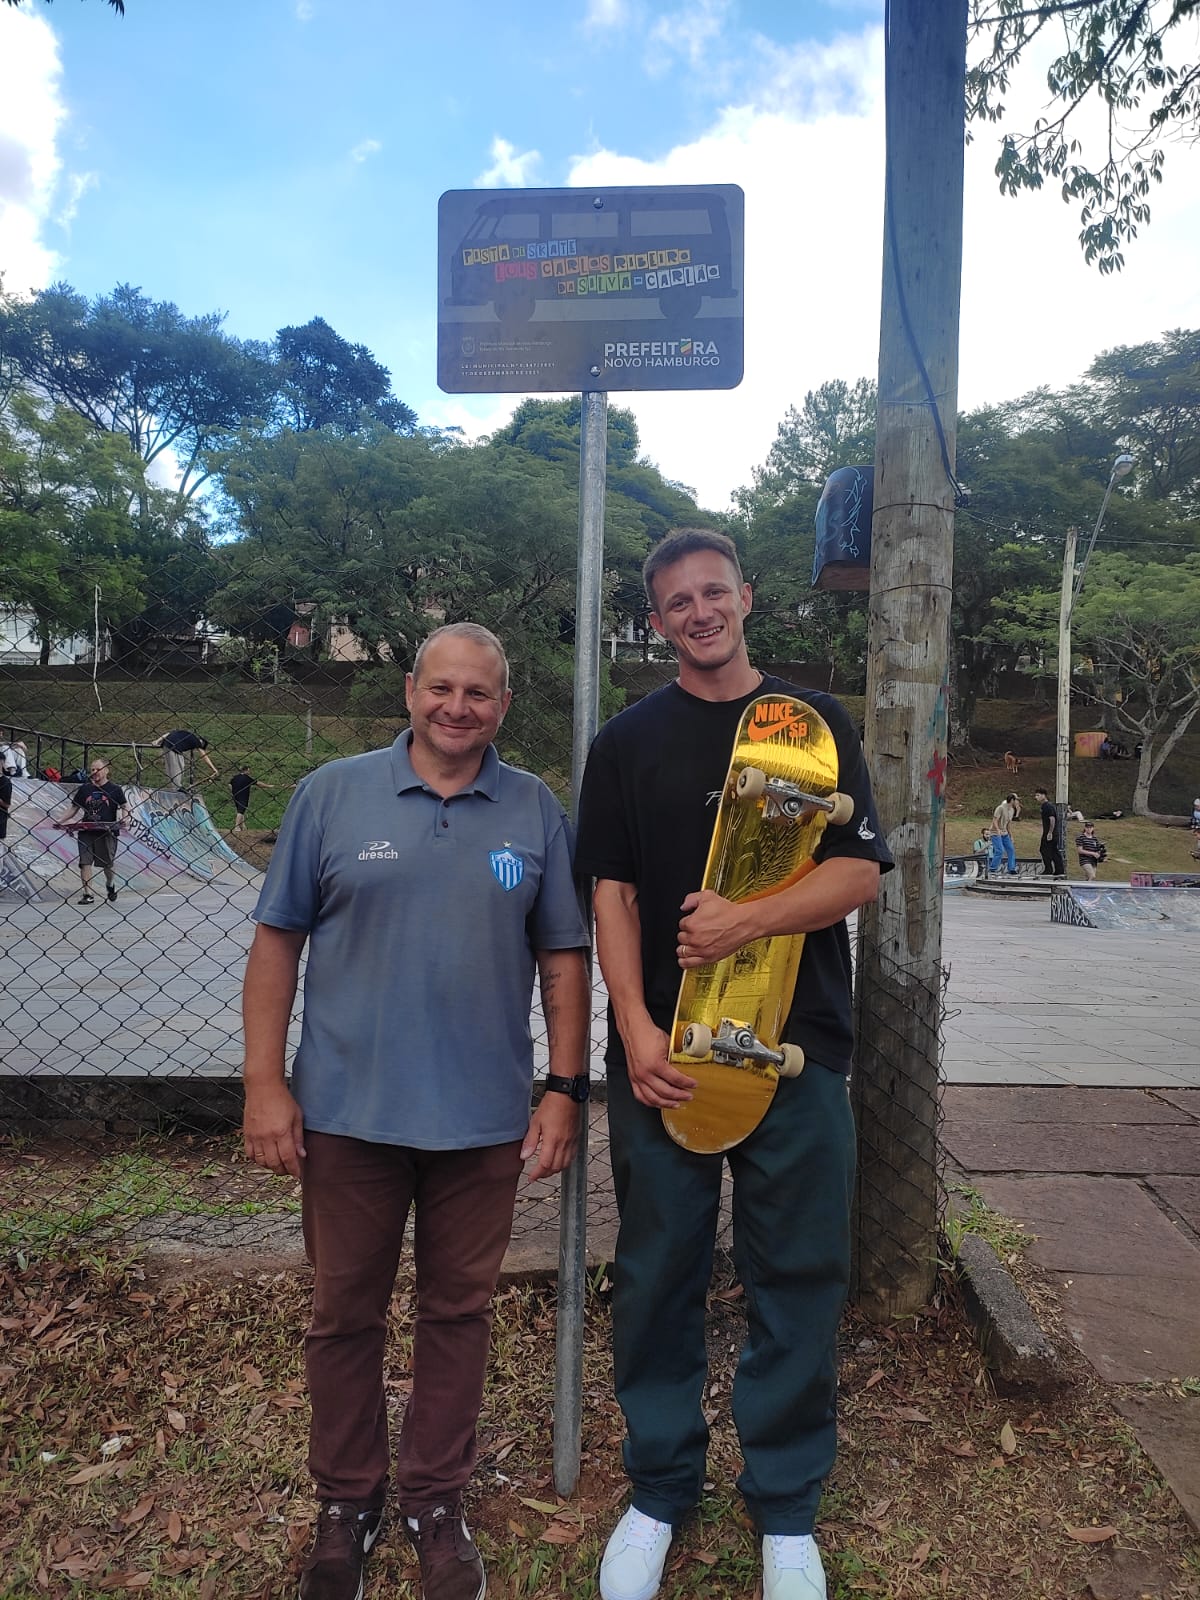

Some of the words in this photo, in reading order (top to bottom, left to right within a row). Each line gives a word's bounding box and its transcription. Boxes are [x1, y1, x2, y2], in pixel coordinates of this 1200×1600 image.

[463, 245, 509, 265] PISTA
[527, 239, 577, 259] SKATE
[495, 262, 537, 282] LUIS
[541, 255, 609, 277] CARLOS
[614, 249, 690, 271] RIBEIRO
[558, 281, 574, 294] DA
[577, 272, 632, 295] SILVA
[604, 358, 642, 368] NOVO
[645, 356, 720, 367] HAMBURGO
[755, 703, 794, 722] NIKE
[789, 722, 807, 738] SB
[358, 849, 398, 861] dresch
